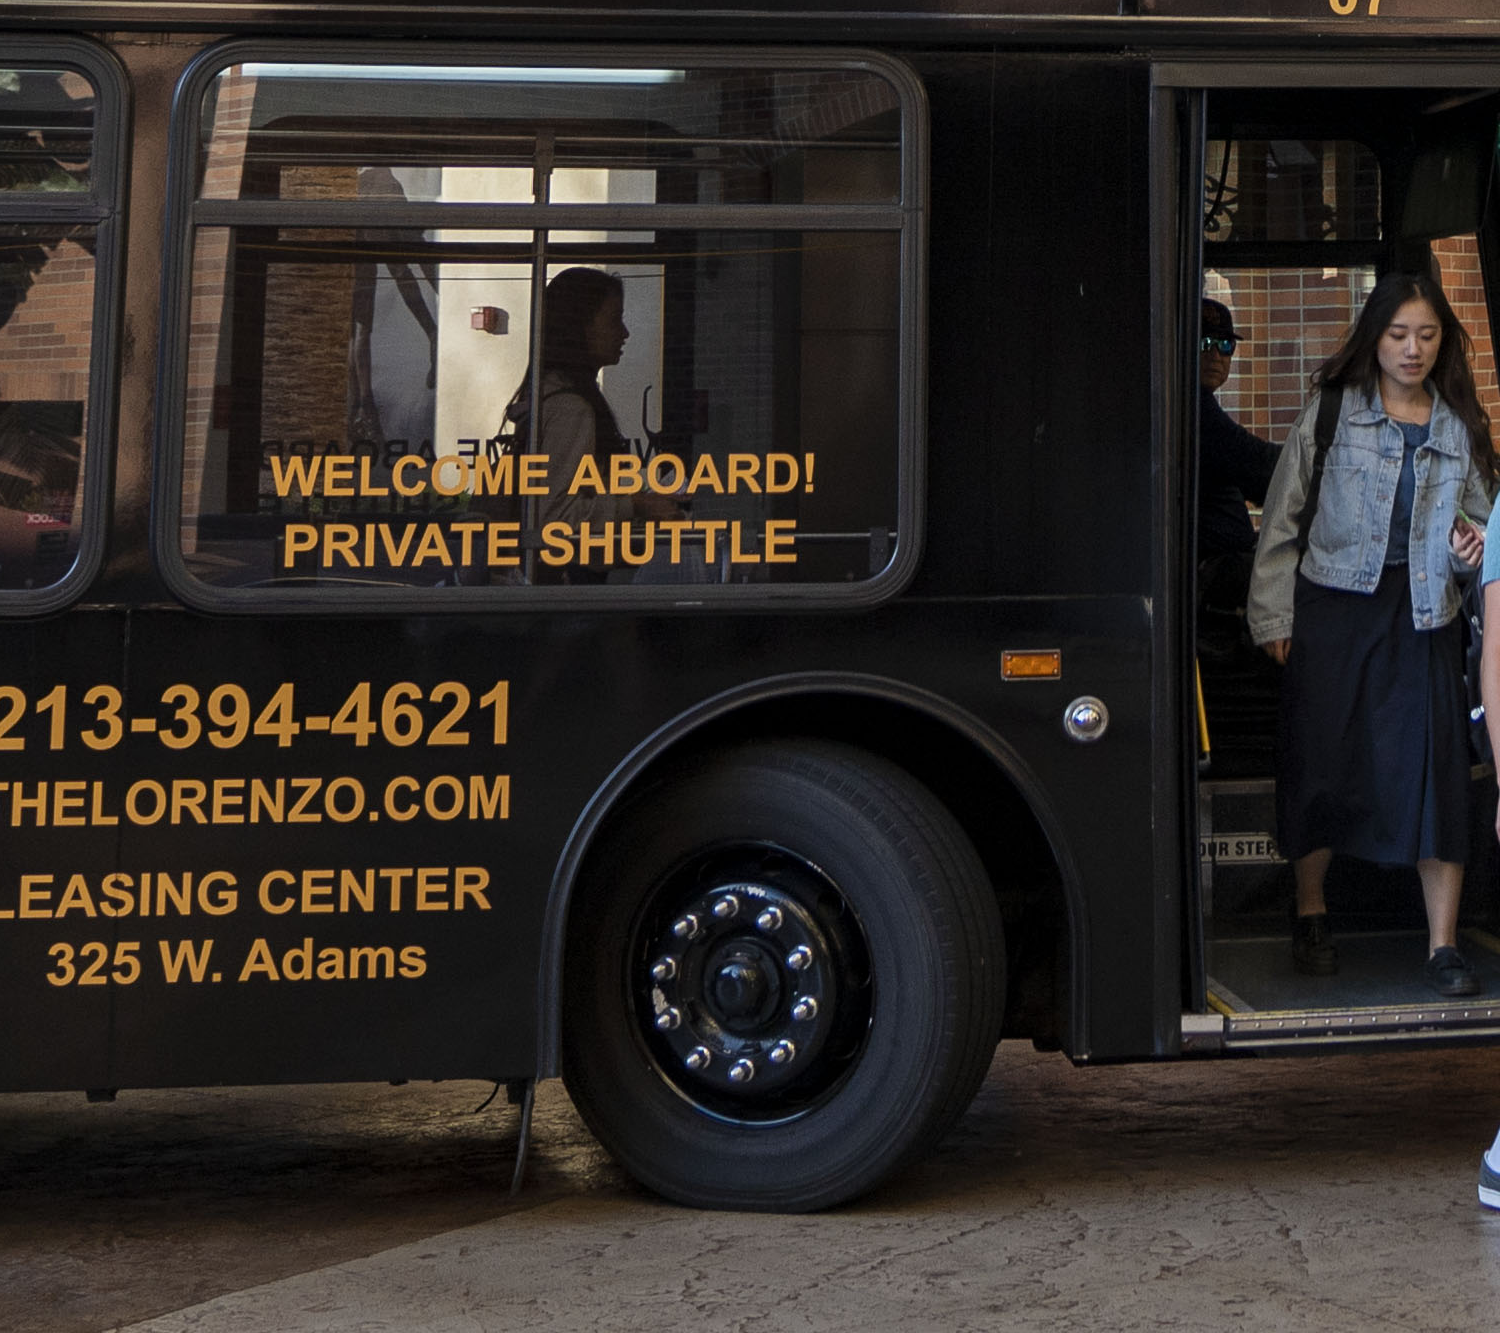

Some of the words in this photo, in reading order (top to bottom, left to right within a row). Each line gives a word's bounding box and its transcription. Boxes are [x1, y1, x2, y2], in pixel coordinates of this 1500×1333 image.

[270, 455, 551, 498] WELCOME
[568, 453, 816, 496] ABOARD!
[284, 523, 521, 569] PRIVATE
[540, 520, 798, 567] SHUTTLE
[258, 867, 492, 915] CENTER
[47, 942, 142, 987] 325
[160, 940, 223, 984] W.
[239, 938, 428, 983] Adams
